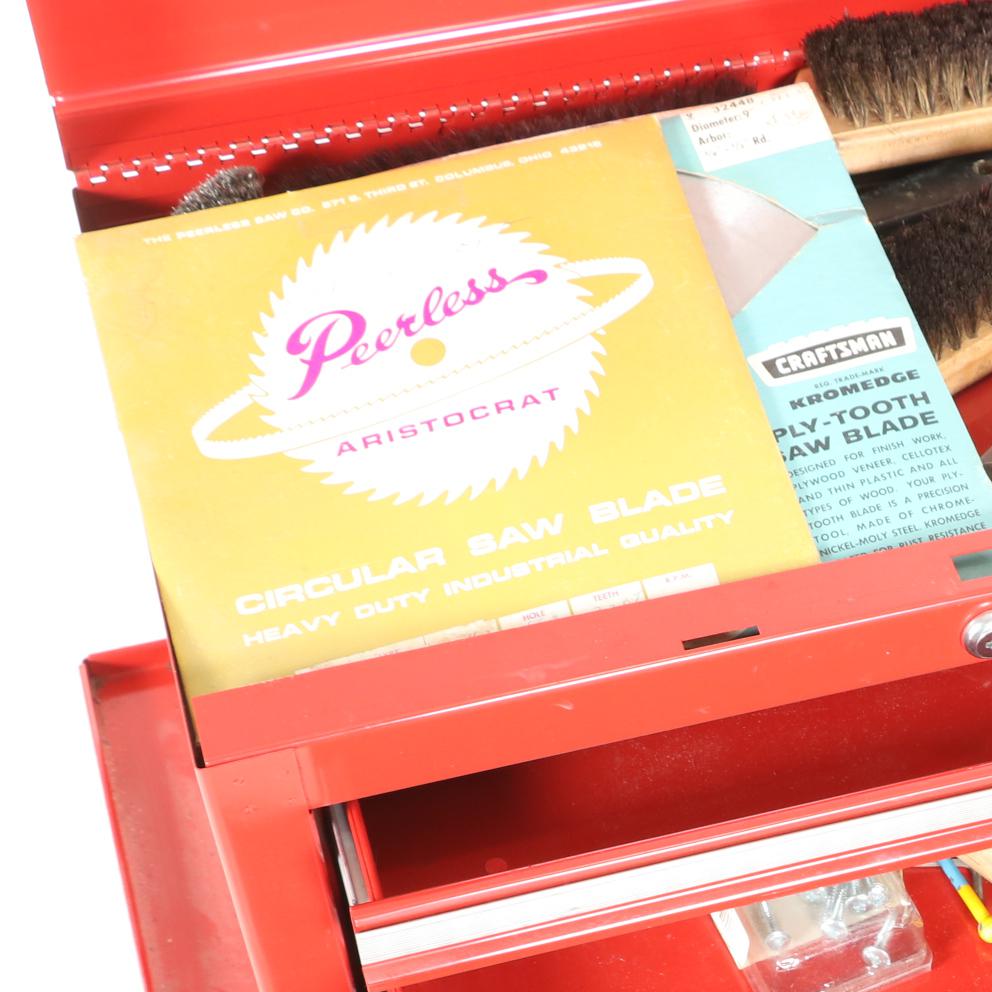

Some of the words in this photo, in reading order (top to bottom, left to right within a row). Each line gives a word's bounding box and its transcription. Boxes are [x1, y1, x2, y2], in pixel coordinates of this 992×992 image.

[143, 235, 172, 245] THE
[176, 219, 250, 241] PEERLESS
[254, 211, 288, 225] SAW
[291, 205, 315, 217] CO.
[364, 183, 407, 200] THIRD
[409, 178, 429, 190] ST.
[518, 150, 553, 165] OHIO
[286, 268, 548, 400] Peerless
[775, 330, 897, 375] CRAFTSMAN
[789, 369, 920, 410] KROMEDGE
[834, 366, 884, 384] TRADE-MARK
[337, 387, 560, 457] ARISTOCRAT
[773, 391, 931, 443] PLY-TOOTH
[842, 411, 939, 445] BLADE
[844, 451, 865, 462] FOR
[872, 441, 904, 454] FINISH
[902, 445, 952, 461] CELLOTEX
[798, 491, 823, 504] AND
[827, 482, 855, 495] THIN
[860, 469, 904, 486] PLASTIC
[910, 462, 934, 474] AND
[940, 457, 958, 467] ALL
[803, 503, 832, 517] TYPES
[839, 496, 853, 507] OF
[907, 476, 936, 488] YOUR
[941, 471, 964, 481] PLY-
[808, 514, 844, 530] TOOTH
[850, 503, 882, 519] BLADE
[888, 500, 898, 508] IS
[904, 496, 912, 504] A
[917, 483, 969, 501] PRECISION
[857, 516, 891, 532] MADE
[898, 510, 914, 520] OF
[921, 497, 975, 514] CHROME-
[235, 547, 446, 616] CIRCULAR
[467, 512, 564, 557] SAW
[587, 474, 727, 524] BLADE
[819, 531, 888, 557] NICKEL-MOLY
[924, 509, 981, 530] KROMEDGE
[928, 521, 986, 542] RESISTANCE
[242, 611, 341, 647] HEAVY
[354, 587, 430, 620] DUTY
[443, 543, 608, 597] INDUSTRIAL
[619, 510, 735, 549] QUALITY
